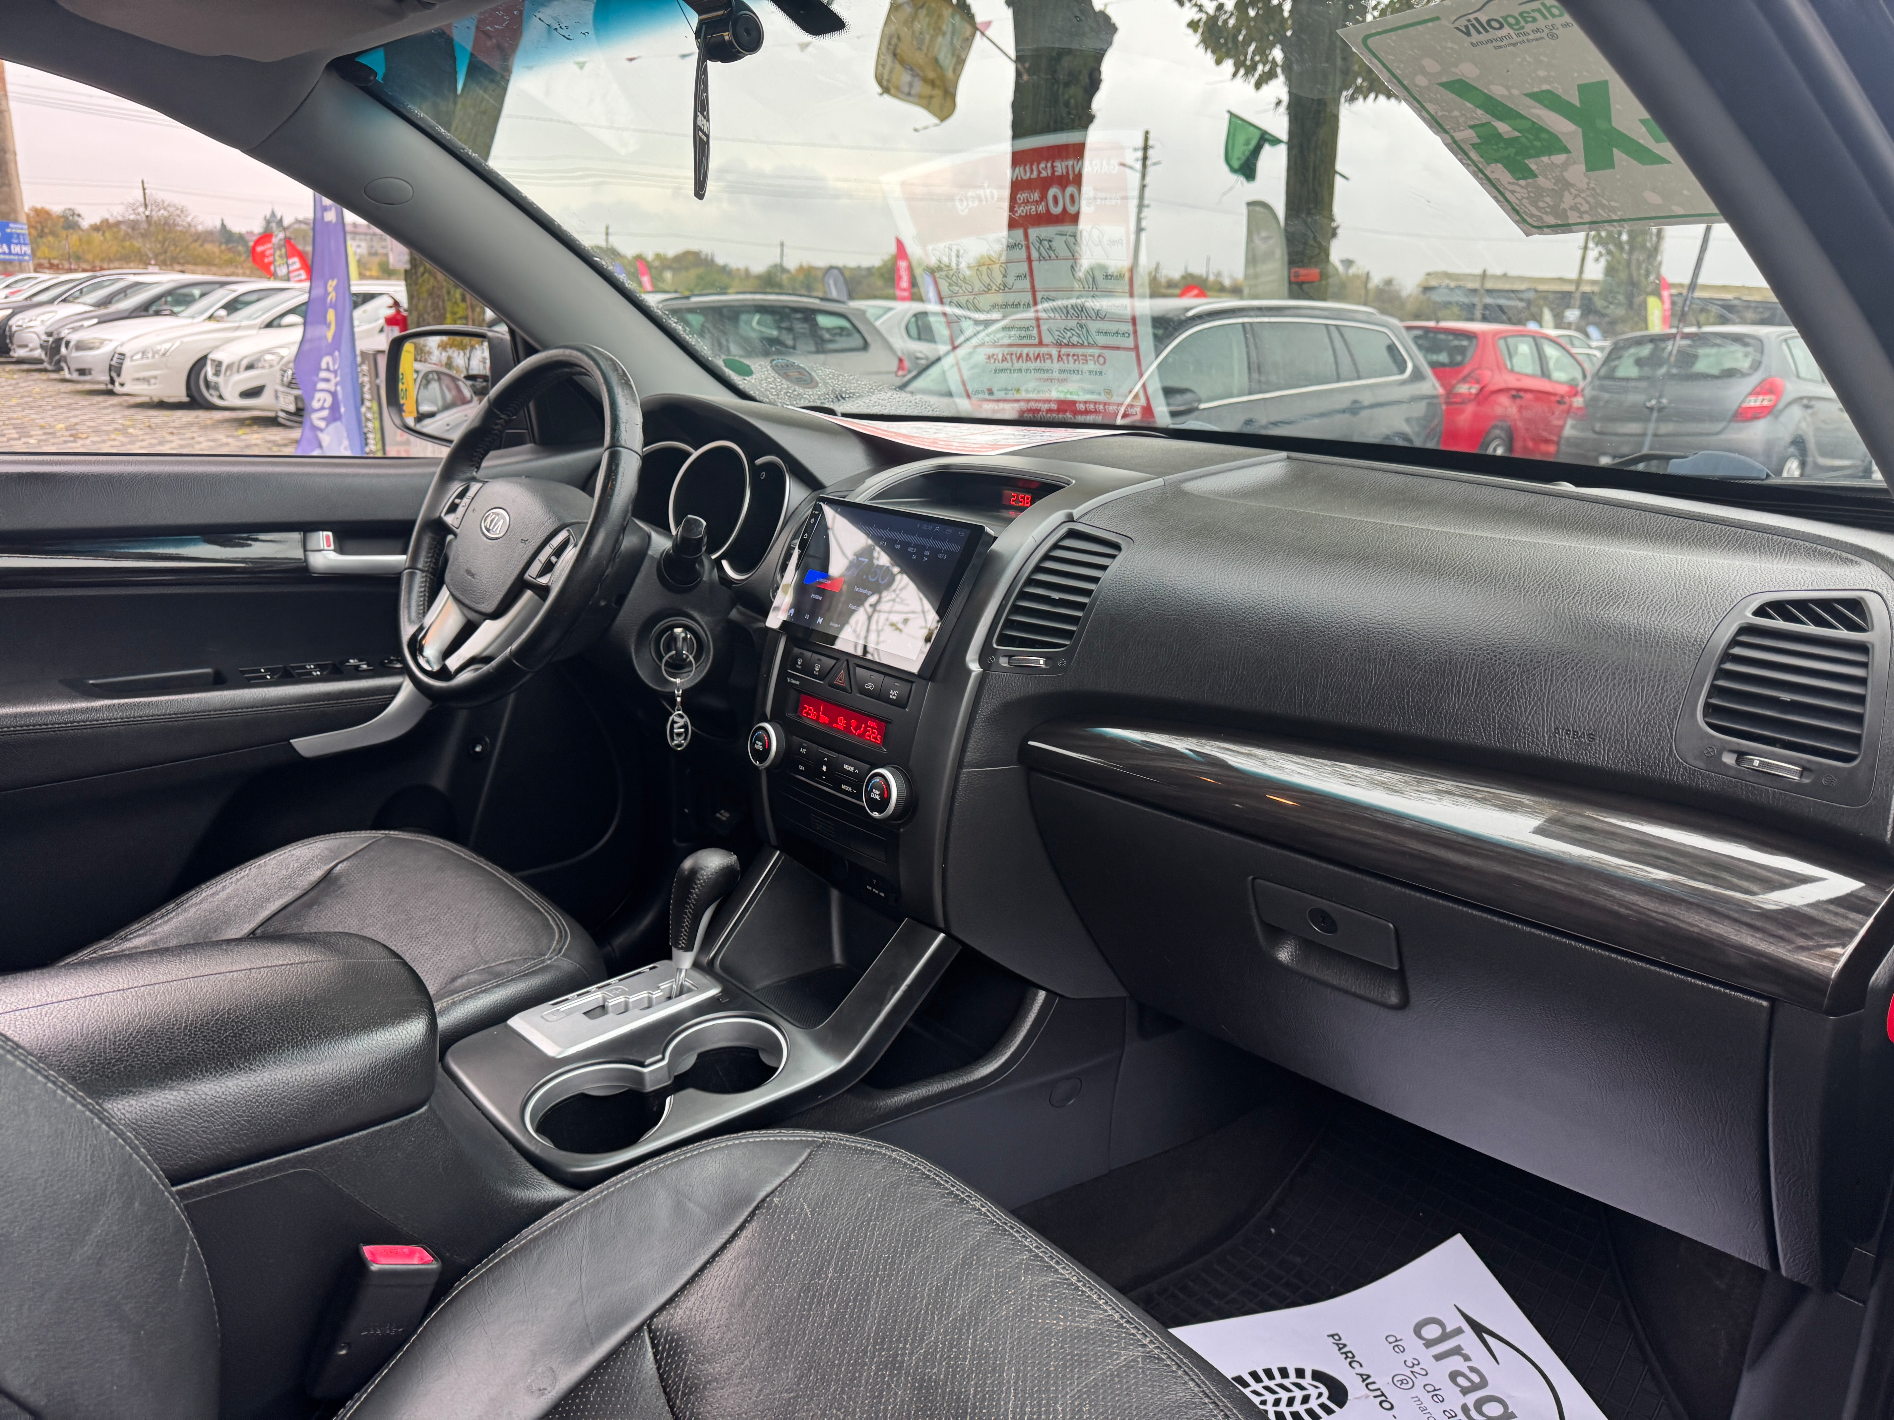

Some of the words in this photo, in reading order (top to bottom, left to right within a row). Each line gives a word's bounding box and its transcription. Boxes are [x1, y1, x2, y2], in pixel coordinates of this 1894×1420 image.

[485, 512, 504, 534] KIA
[1326, 1332, 1364, 1370] PARC
[1354, 1371, 1395, 1412] AUTO
[1384, 1333, 1406, 1354] de
[1403, 1357, 1429, 1380] 32
[1422, 1382, 1445, 1404] de
